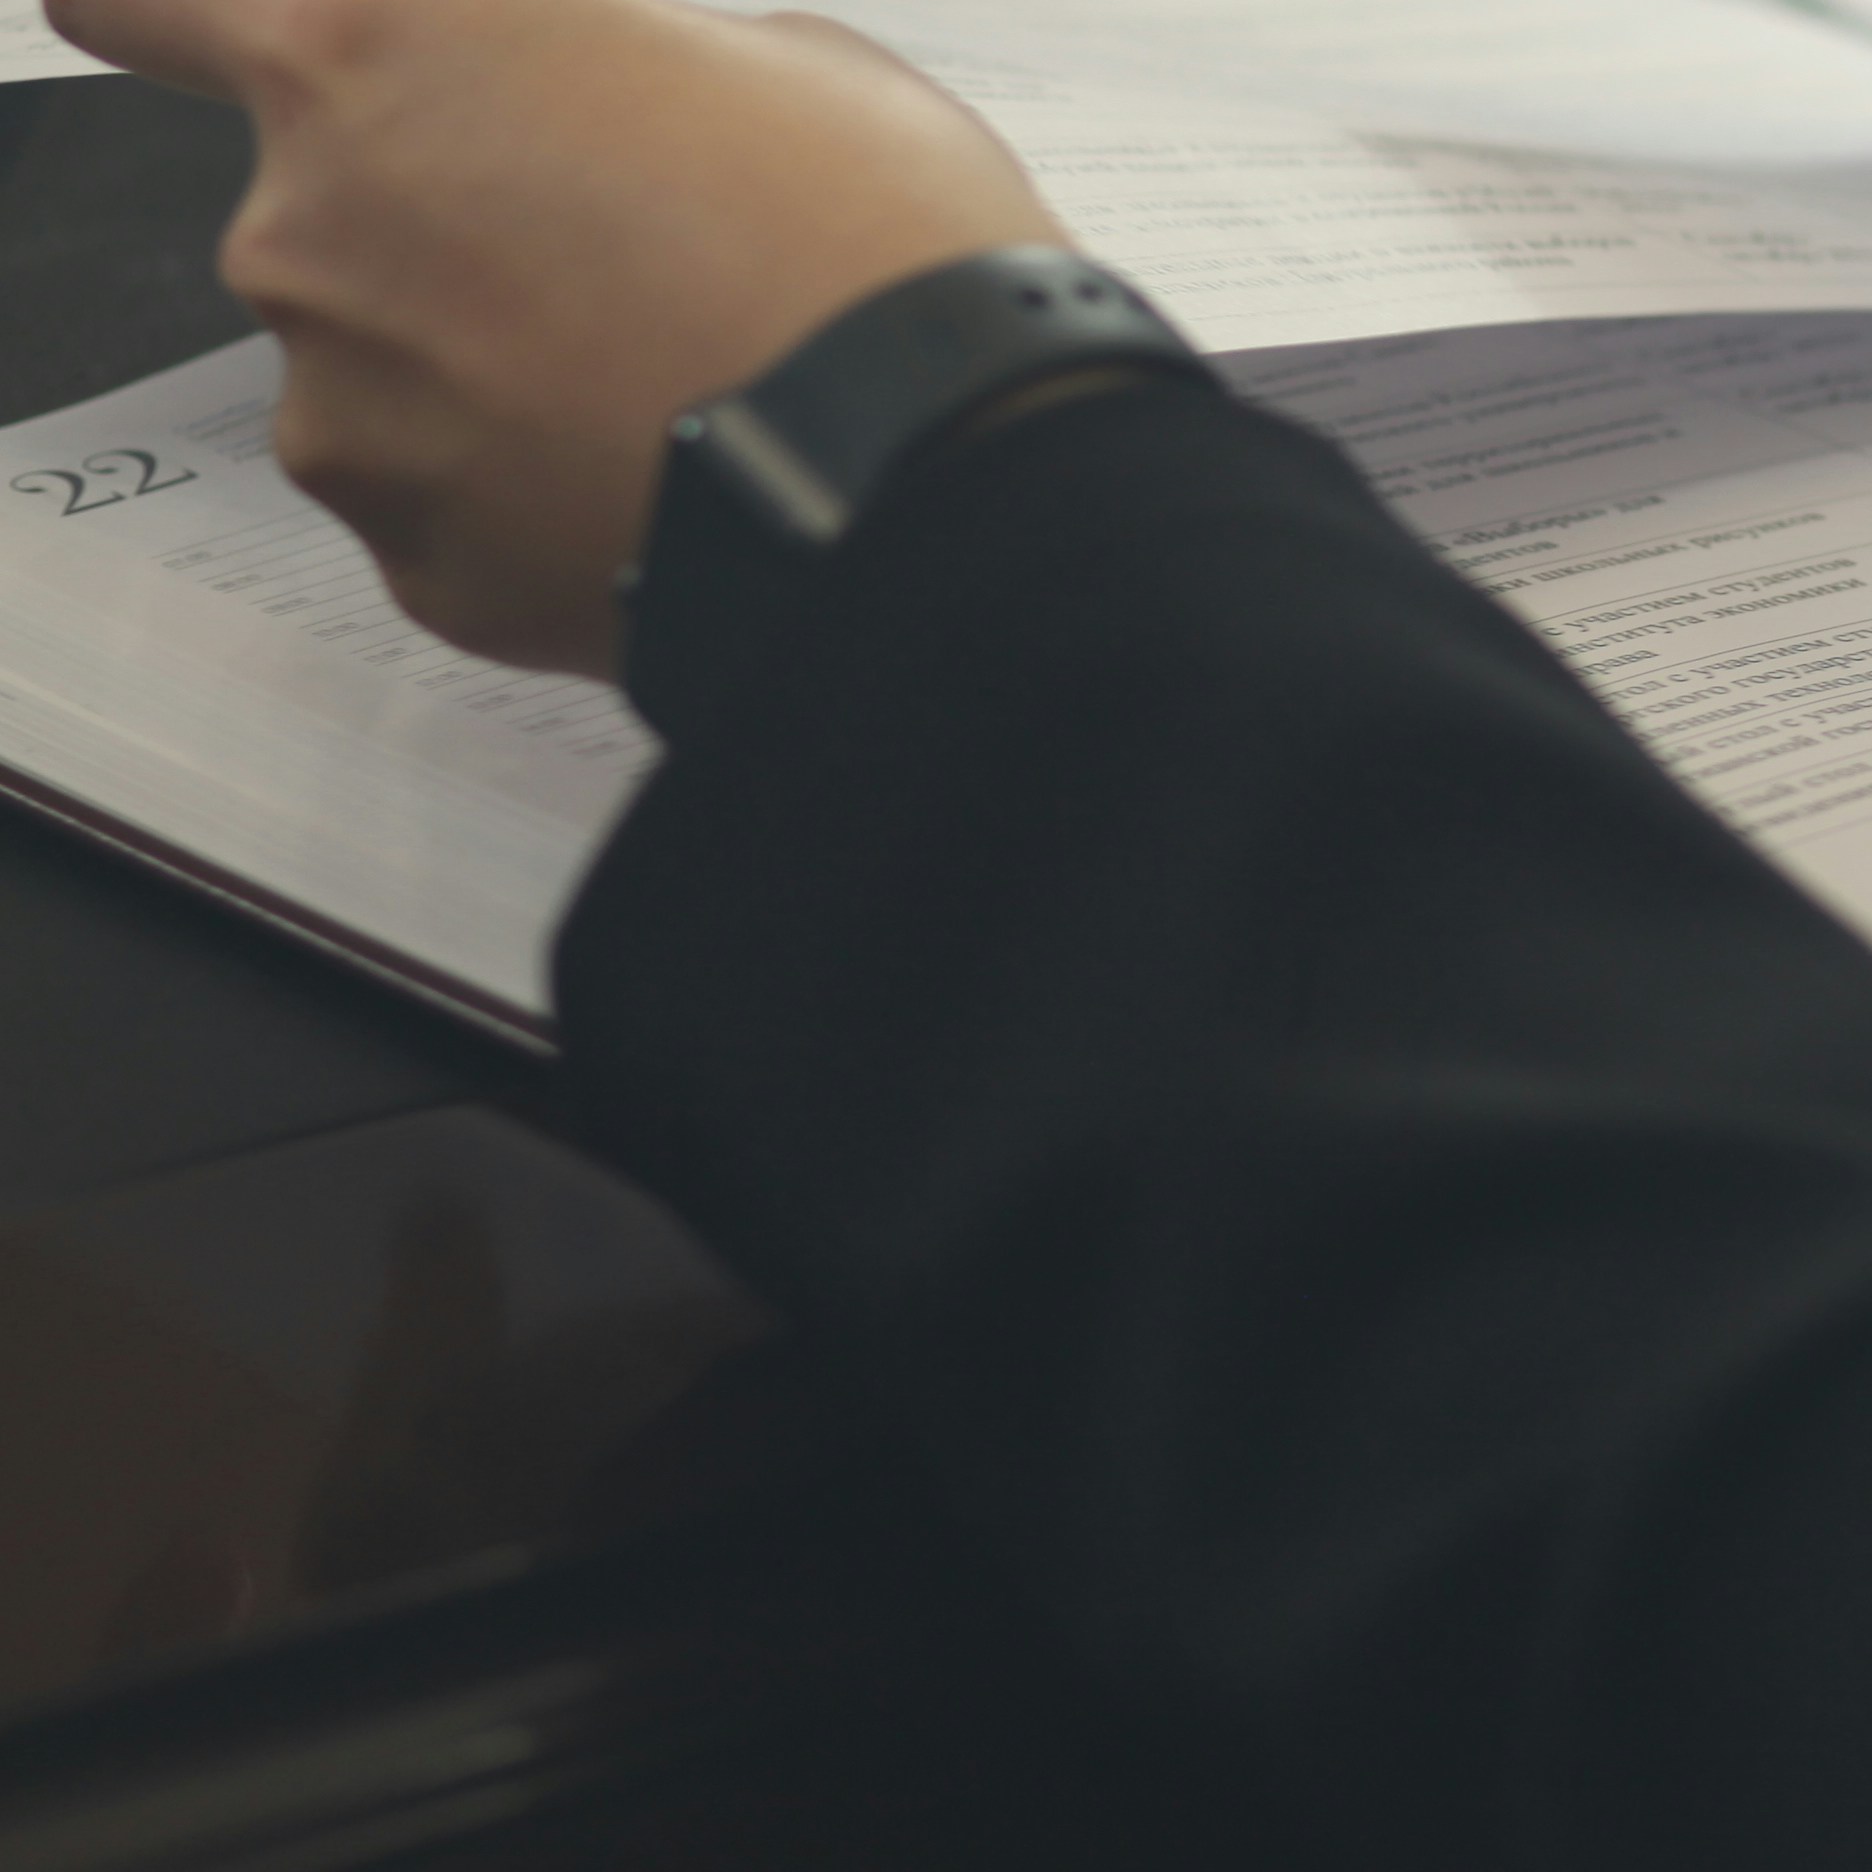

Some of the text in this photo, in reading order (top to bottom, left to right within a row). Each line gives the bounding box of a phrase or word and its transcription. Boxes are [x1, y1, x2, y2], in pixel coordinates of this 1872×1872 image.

[10, 449, 197, 516] 22
[1453, 541, 1559, 571] дентов
[1531, 542, 1687, 583] школьных
[1688, 511, 1826, 550] рисунков
[1543, 557, 1858, 637] с участием студентов
[1704, 578, 1867, 619] экономики
[1668, 673, 1691, 683] с
[1690, 638, 1833, 679] участием
[1706, 724, 1779, 750] стол
[1779, 717, 1803, 728] с
